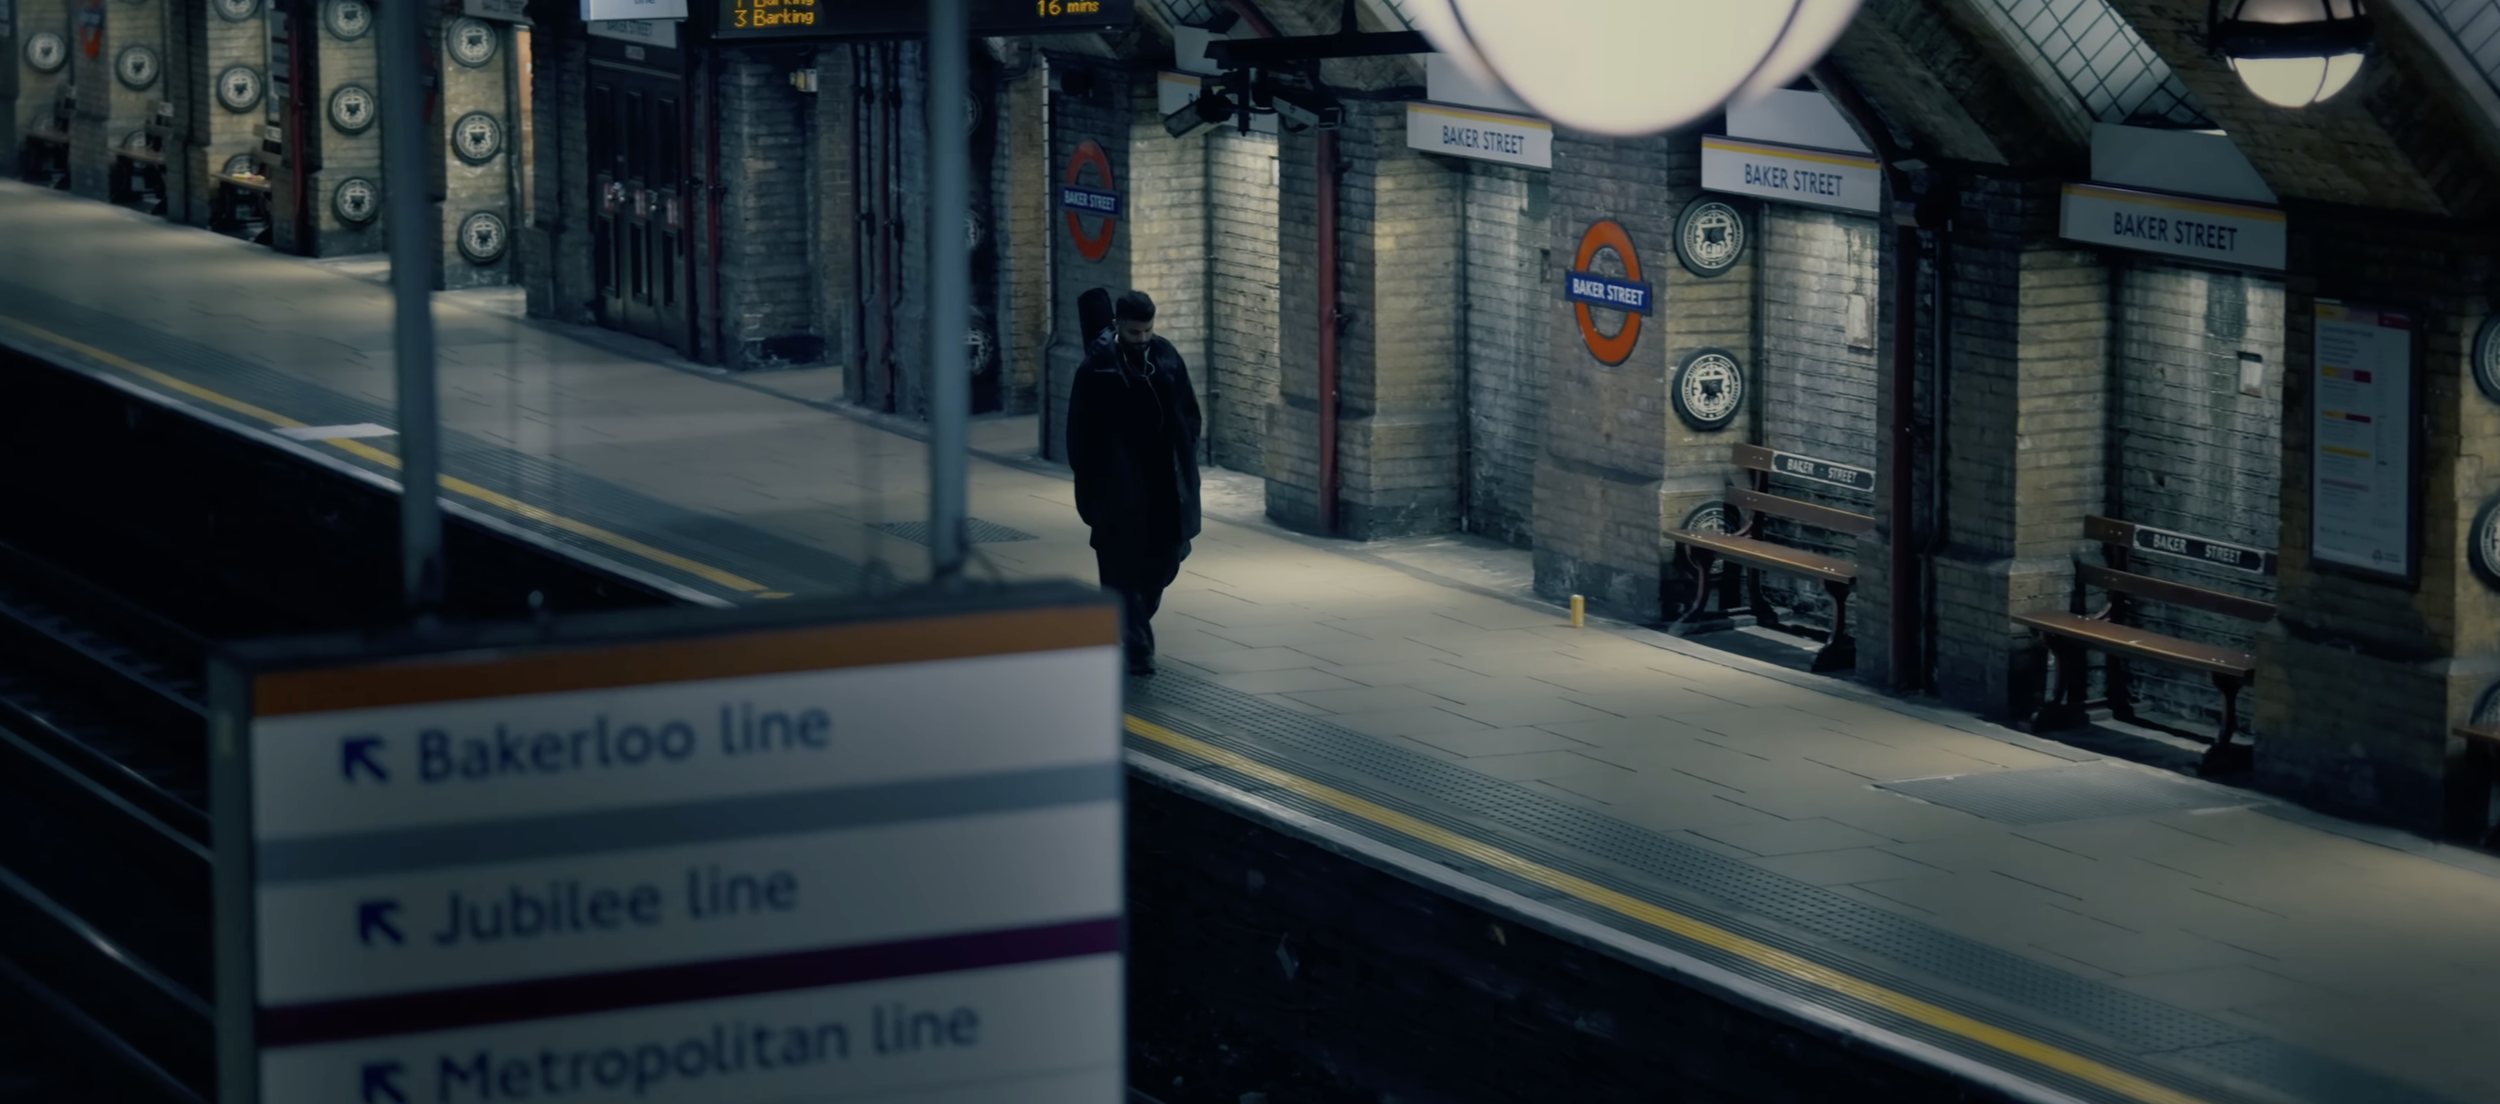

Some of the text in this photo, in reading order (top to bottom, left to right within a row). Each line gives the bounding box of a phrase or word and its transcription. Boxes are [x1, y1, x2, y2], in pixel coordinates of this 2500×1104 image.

[734, 8, 815, 27] 3 Barking
[1037, 0, 1100, 17] 16 mins
[1443, 125, 1524, 154] BAKER STREET
[1745, 163, 1842, 196] BAKER STREET
[1064, 189, 1116, 211] BAKER STREET
[2114, 212, 2237, 251] BAKER STREET
[1573, 278, 1644, 306] BAKER STREET
[1787, 458, 1858, 483] BAKER STREET
[2153, 534, 2242, 564] BAKER STREET
[419, 703, 831, 783] Bakerloo line
[433, 865, 799, 946] Jubilee line
[437, 1003, 980, 1104] Metropolitan line
